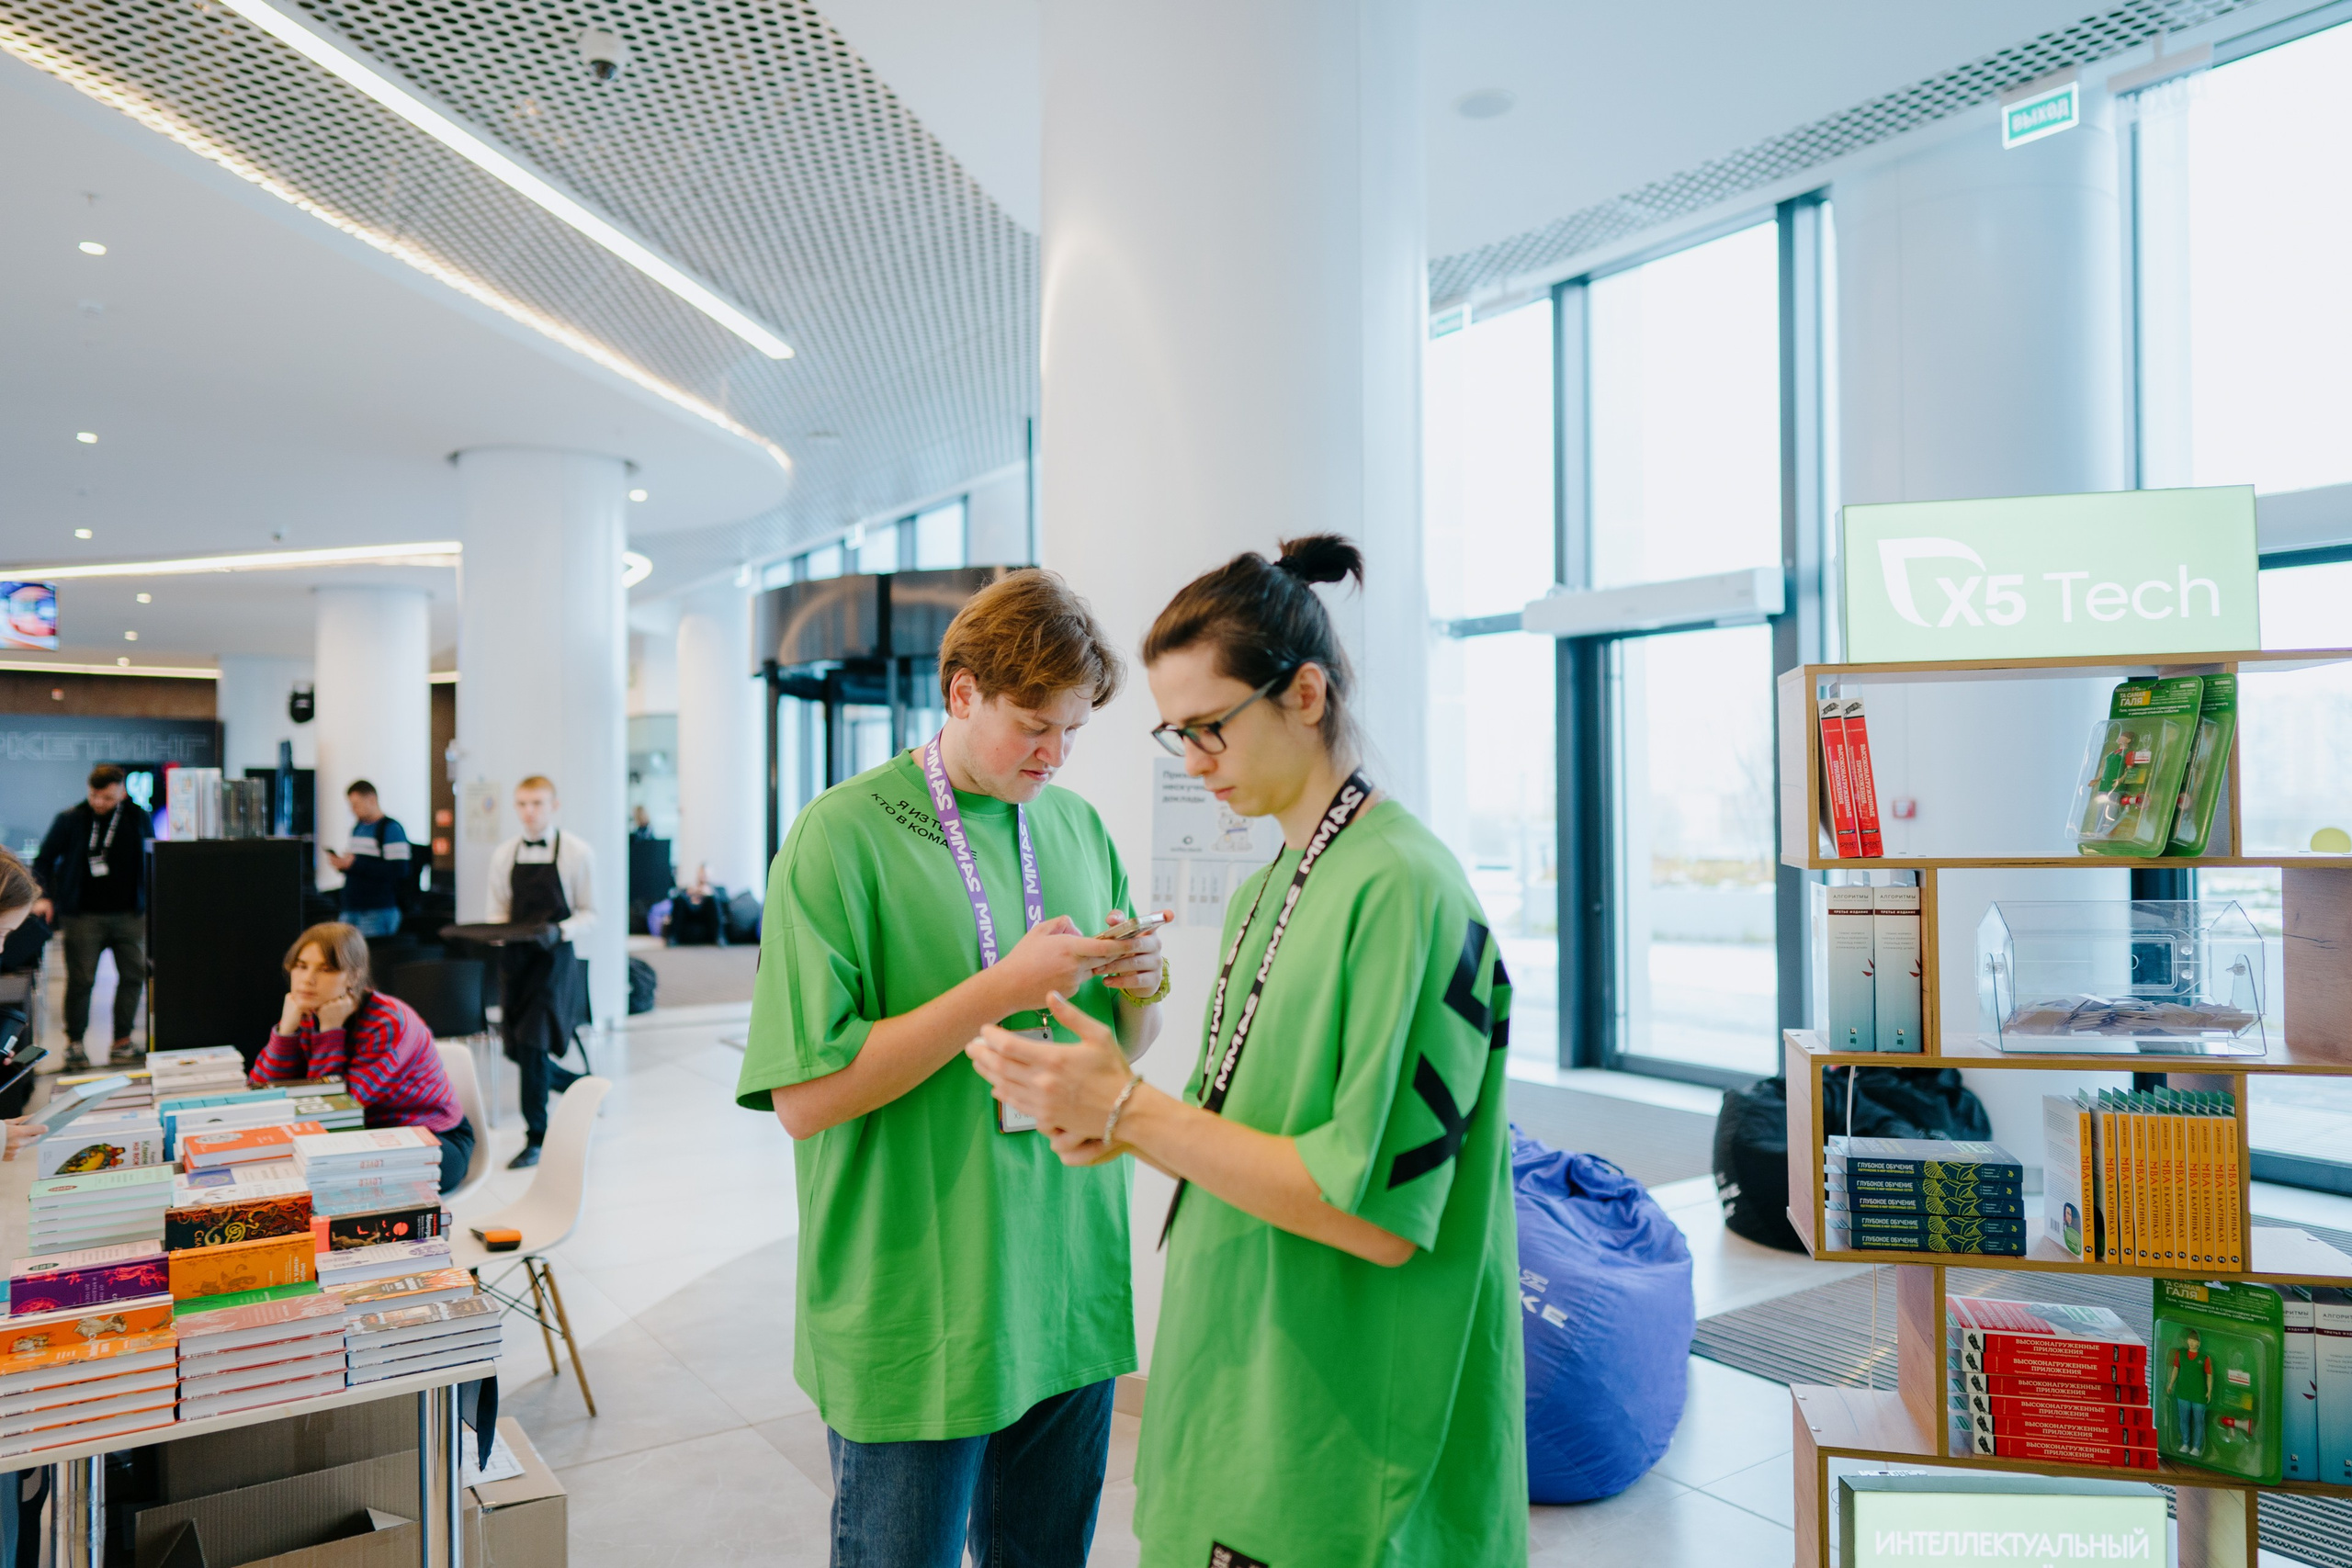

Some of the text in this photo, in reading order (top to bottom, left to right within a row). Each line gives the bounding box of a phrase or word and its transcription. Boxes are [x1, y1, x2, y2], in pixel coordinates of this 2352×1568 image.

[2011, 97, 2069, 132] ВЫХОД
[2043, 565, 2221, 623] Tech
[2120, 697, 2143, 706] ГАЛЯ
[0, 731, 207, 761] КЕТИНГ
[1833, 761, 1843, 805] ПРИЛОЖЕНИЯ
[1837, 744, 1852, 818] ВЫСОКОНАГРУЖЕННЫЕ
[1856, 760, 1868, 804] ПРИЛОЖЕНИЯ
[1860, 744, 1875, 818] ВЫСОКОНАГРУЖЕННЫЕ
[871, 793, 896, 815] КТО
[896, 815, 908, 824] В
[897, 800, 910, 810] Я
[908, 807, 929, 823] ИЗ
[1861, 1217, 1918, 1226] ГЛУБОКОЕ ОБУЧЕНИЕ
[2174, 1281, 2201, 1291] САМАЯ
[2165, 1287, 2198, 1299] ГАЛЯ
[2016, 1338, 2100, 1350] ВЫСОКОНАГРУЖЕННЫЕ
[2033, 1345, 2084, 1356] ПРИЛОЖЕНИЯ
[2013, 1358, 2098, 1371] ВЫСОКОНАГРУЖЕННЫЕ
[2030, 1365, 2082, 1375] ПРИЛОЖЕНИЯ
[2018, 1380, 2102, 1391] ВЫСОКОНАГРУЖЕННЫЕ
[2036, 1387, 2086, 1396] ПРИЛОЖЕНИЯ
[2021, 1401, 2106, 1413] ВЫСОКОНАГРУЖЕННЫЕ
[2039, 1408, 2089, 1418] ПРИЛОЖЕНИЯ
[2025, 1421, 2109, 1433] ВЫСОКОНАГРУЖЕННЫЕ
[2042, 1428, 2093, 1438] ПРИЛОЖЕНИЯ
[2026, 1441, 2110, 1454] ВЫСОКОНАГРУЖЕННЫЕ
[2043, 1449, 2095, 1459] ПРИЛОЖЕНИЯ
[1875, 1528, 2149, 1560] ИНТЕЛЛЕКТУАЛЬНЫЙ
